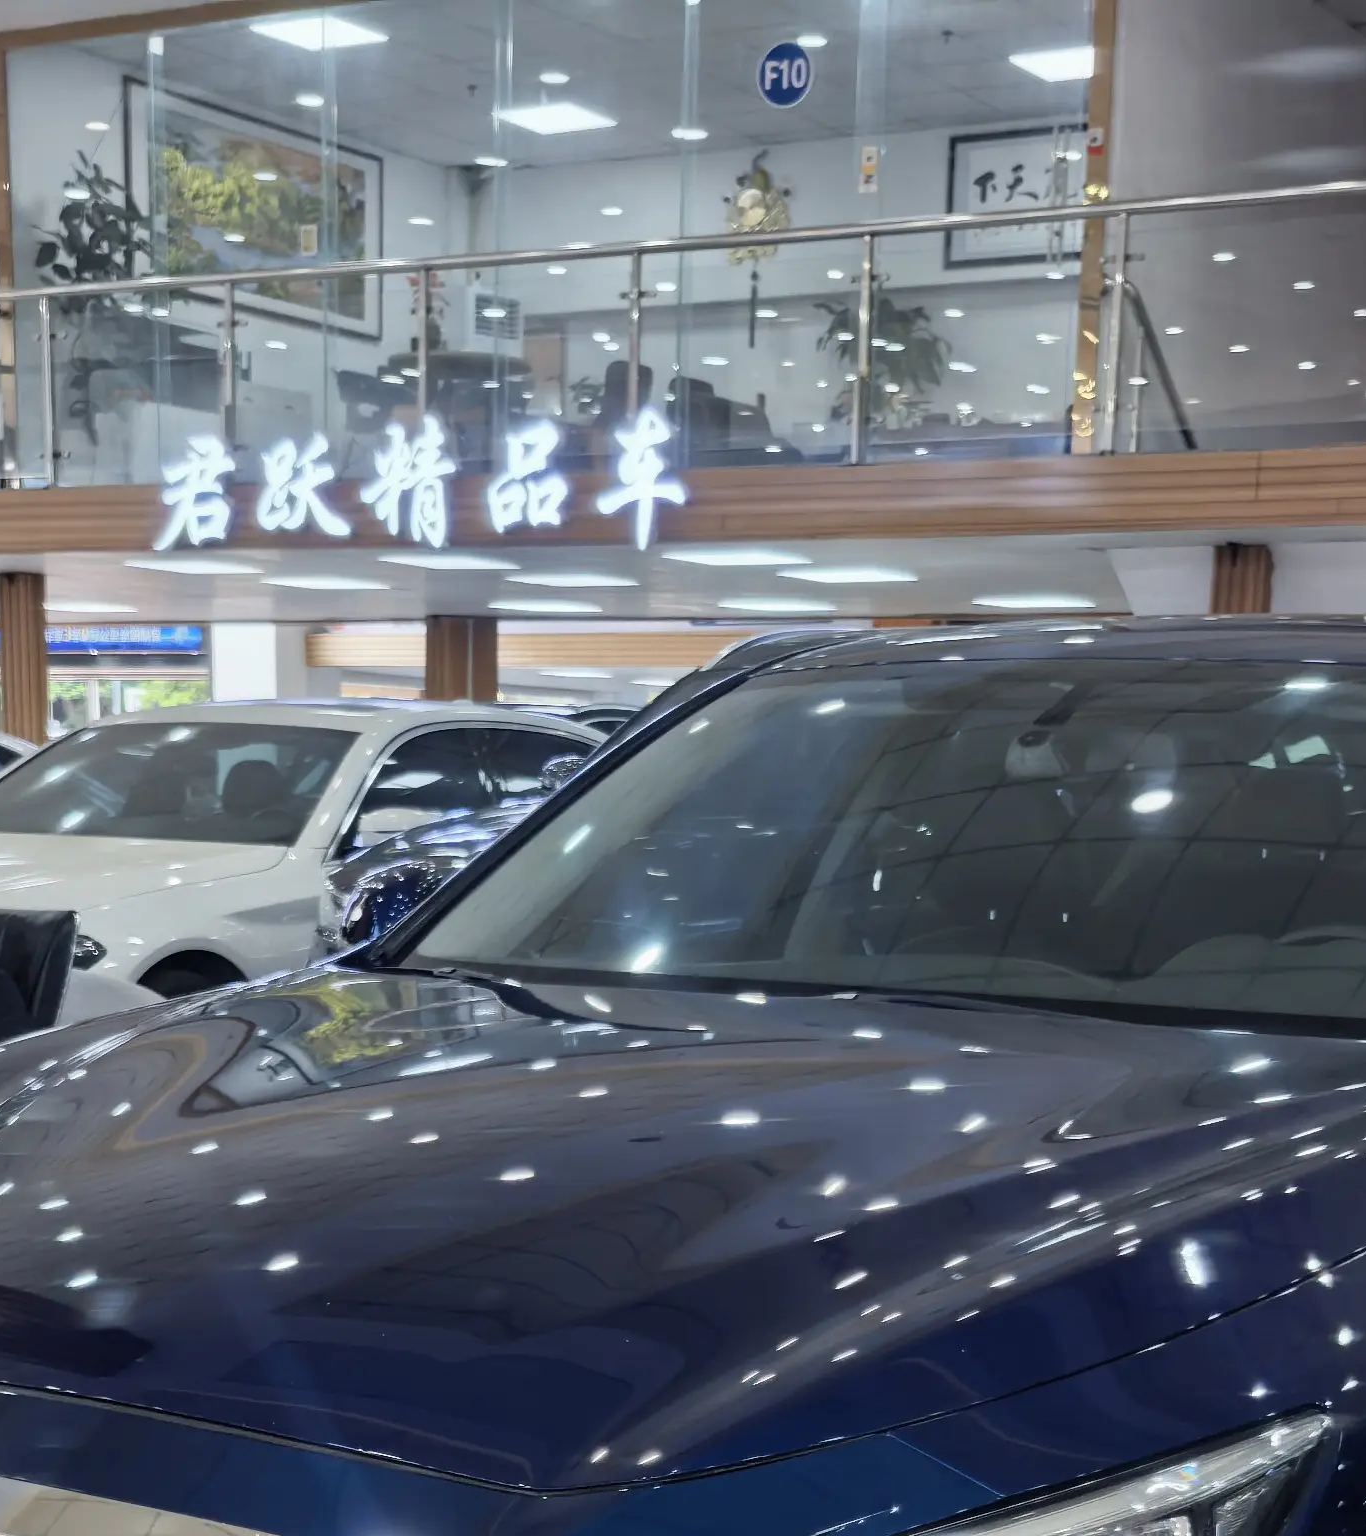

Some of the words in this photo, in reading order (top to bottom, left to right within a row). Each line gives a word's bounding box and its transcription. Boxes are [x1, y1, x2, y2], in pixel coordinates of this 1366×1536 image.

[765, 58, 807, 90] F10
[154, 409, 688, 551] 君跃精品车
